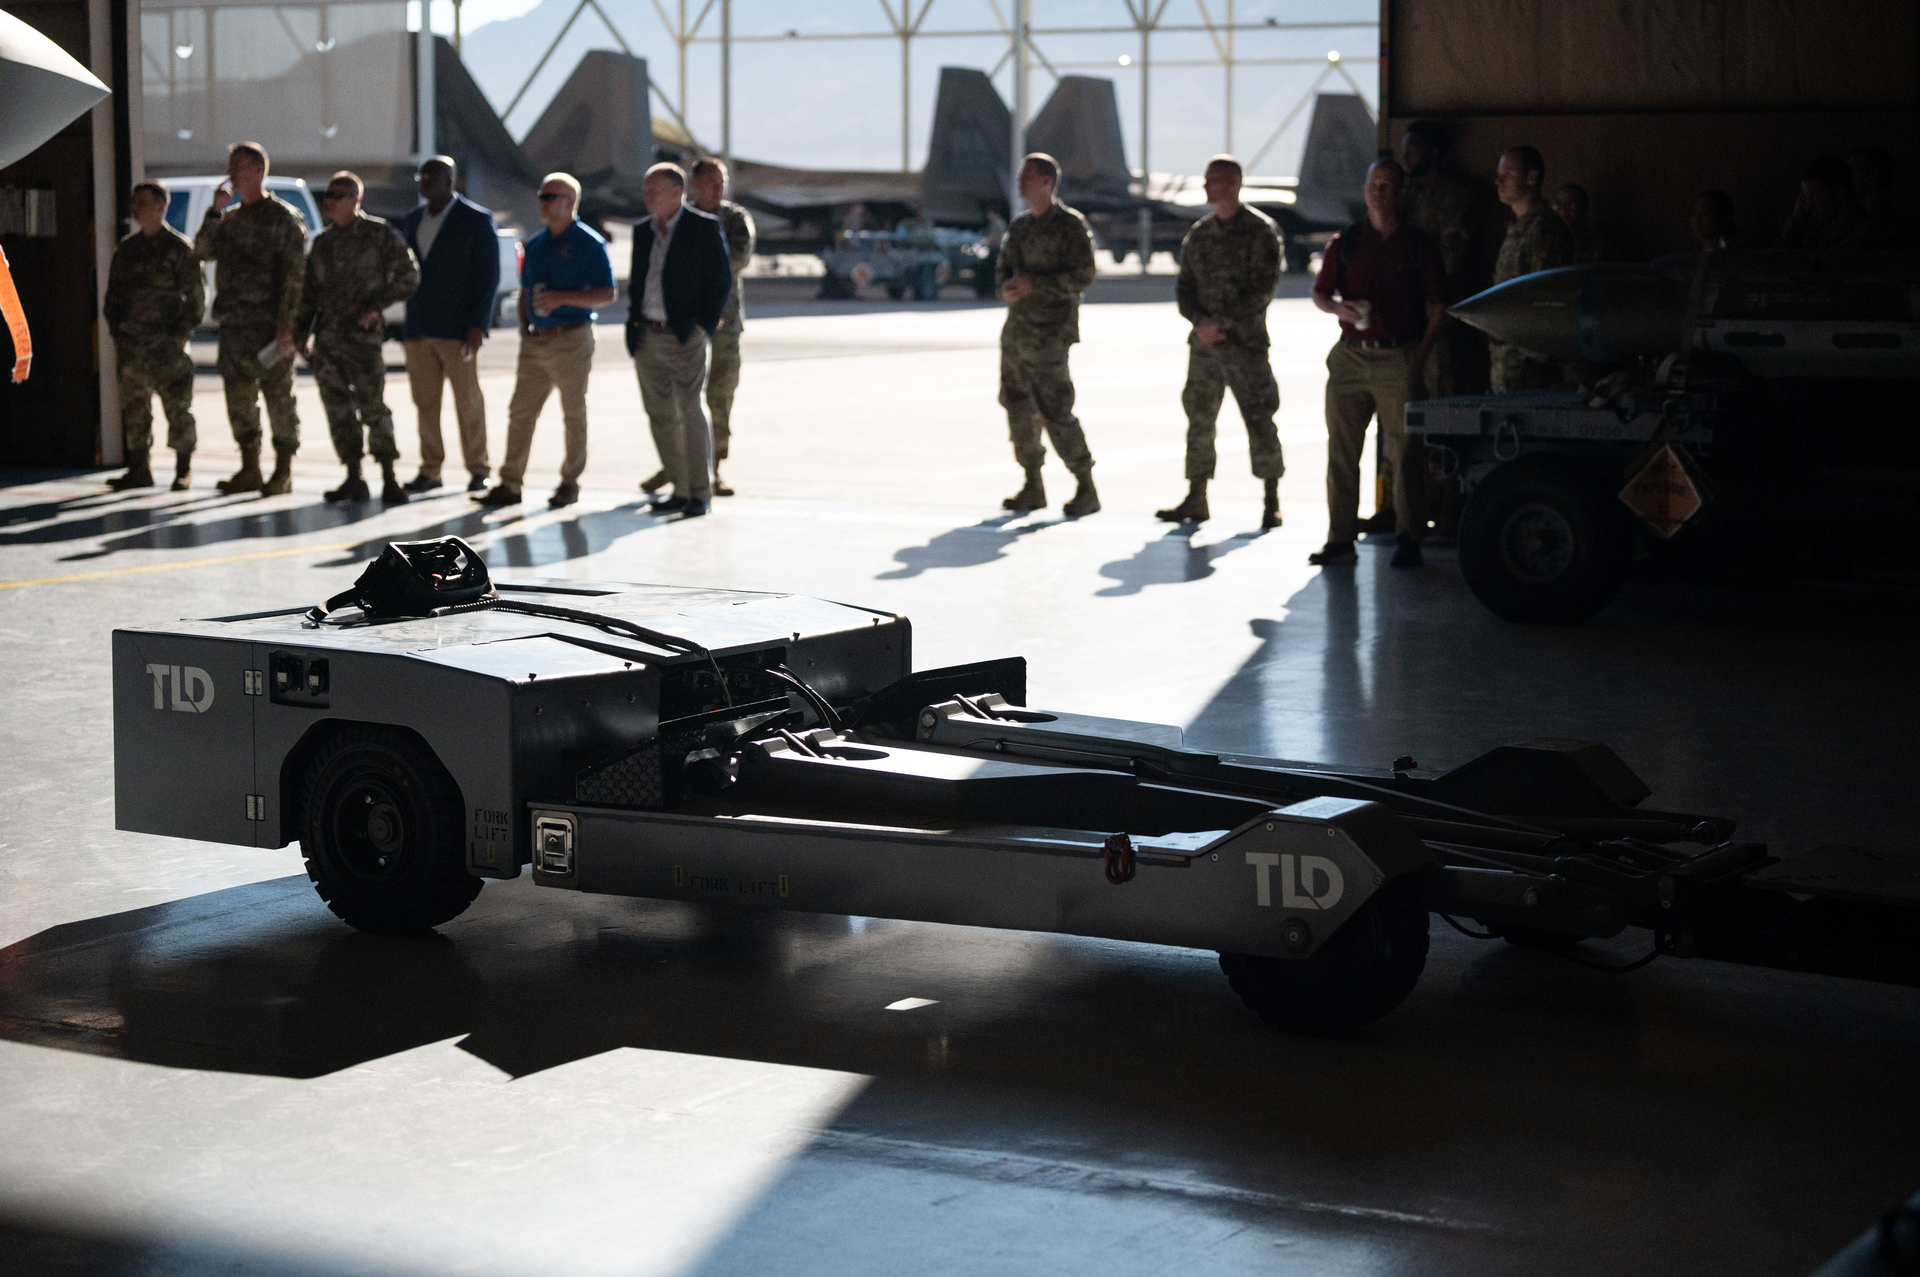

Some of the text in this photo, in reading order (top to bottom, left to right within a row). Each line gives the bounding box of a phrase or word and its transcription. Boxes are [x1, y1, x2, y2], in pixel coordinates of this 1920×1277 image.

[146, 664, 214, 713] TLD
[475, 808, 508, 825] FORK
[475, 825, 508, 842] LIFT
[690, 875, 777, 895] FORK LIFT
[1245, 852, 1344, 910] TLD
